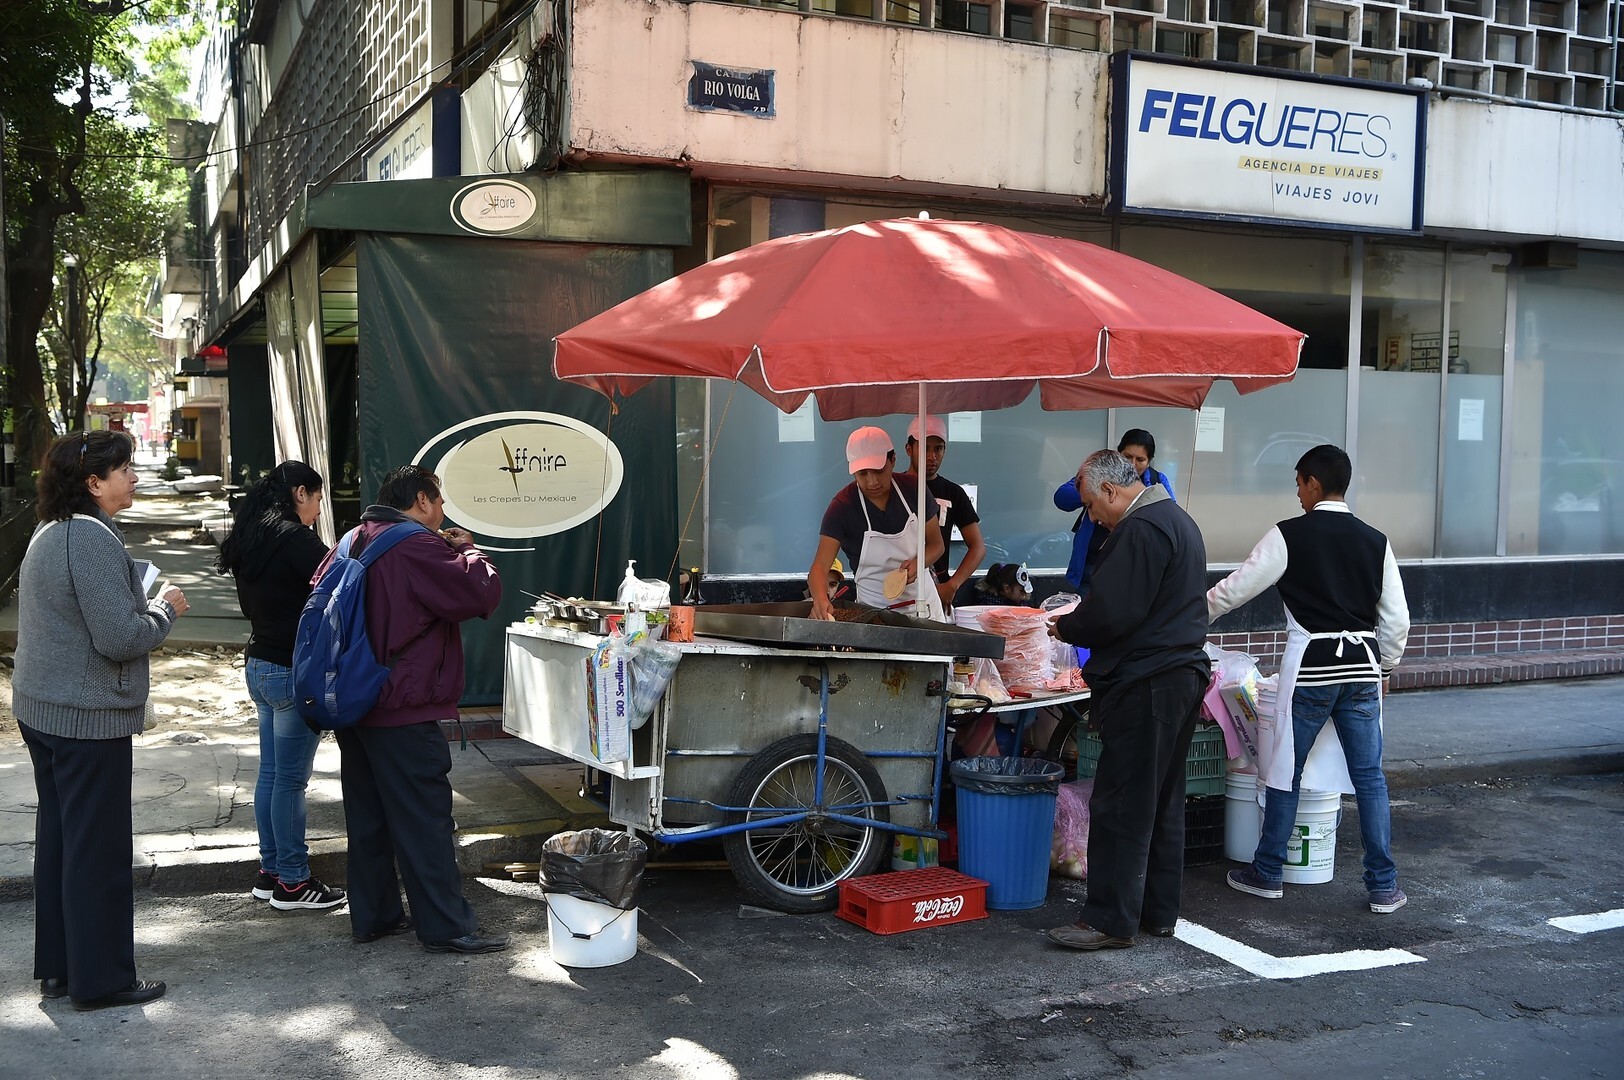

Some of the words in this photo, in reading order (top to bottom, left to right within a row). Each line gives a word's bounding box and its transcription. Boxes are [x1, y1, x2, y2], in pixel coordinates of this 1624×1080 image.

[704, 80, 724, 96] RIO
[727, 83, 760, 101] VOLGA
[1138, 88, 1392, 158] FELGUERES
[1244, 158, 1301, 173] AGENCIA
[1310, 165, 1326, 175] DE
[1334, 167, 1379, 180] VIAJES
[480, 191, 515, 216] Affaire
[1275, 183, 1332, 201] VIAJES
[1342, 191, 1379, 206] JOVI
[489, 495, 522, 503] Crepes
[538, 495, 577, 503] Mexique
[616, 699, 625, 717] 500
[912, 895, 964, 923] Coca-Cola
